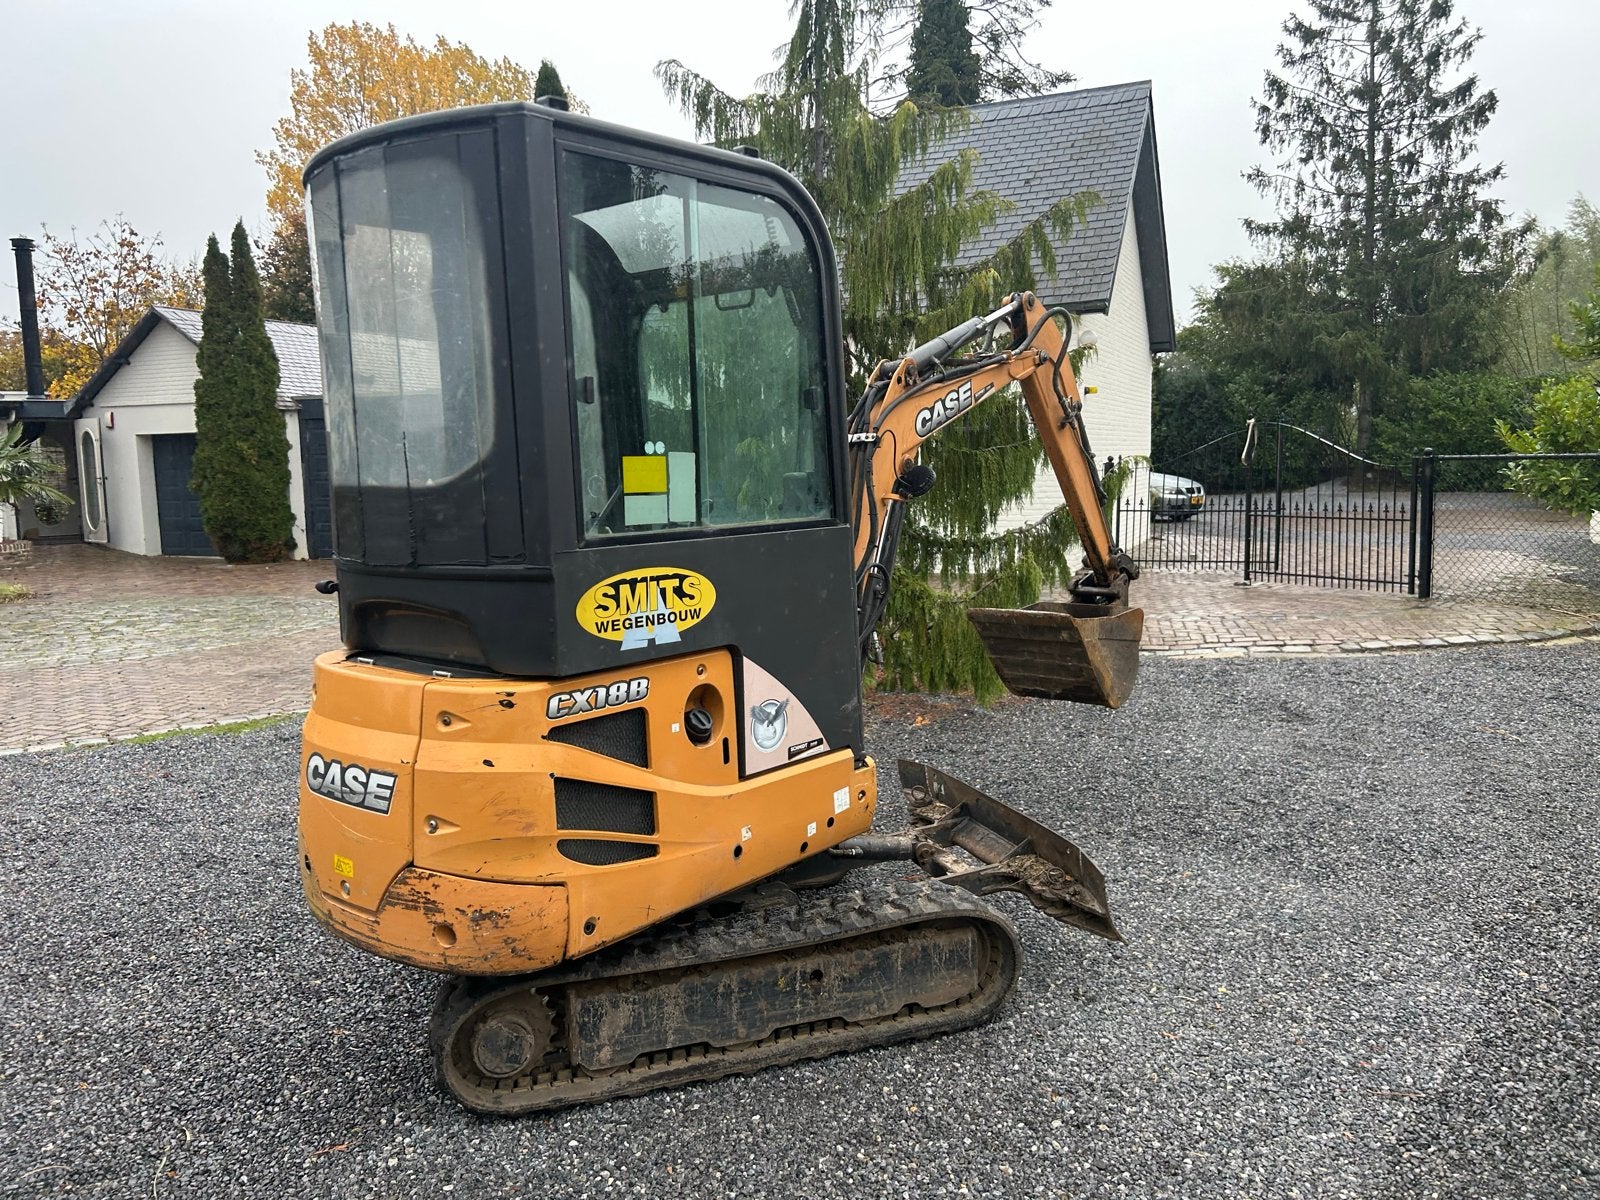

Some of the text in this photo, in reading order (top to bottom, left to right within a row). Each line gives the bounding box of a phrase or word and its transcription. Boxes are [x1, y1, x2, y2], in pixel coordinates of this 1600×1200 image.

[916, 380, 972, 436] CASE
[594, 573, 702, 619] SMITS
[595, 607, 702, 634] WEGENBOUW
[548, 678, 649, 718] CX18B
[307, 755, 396, 813] CASE
